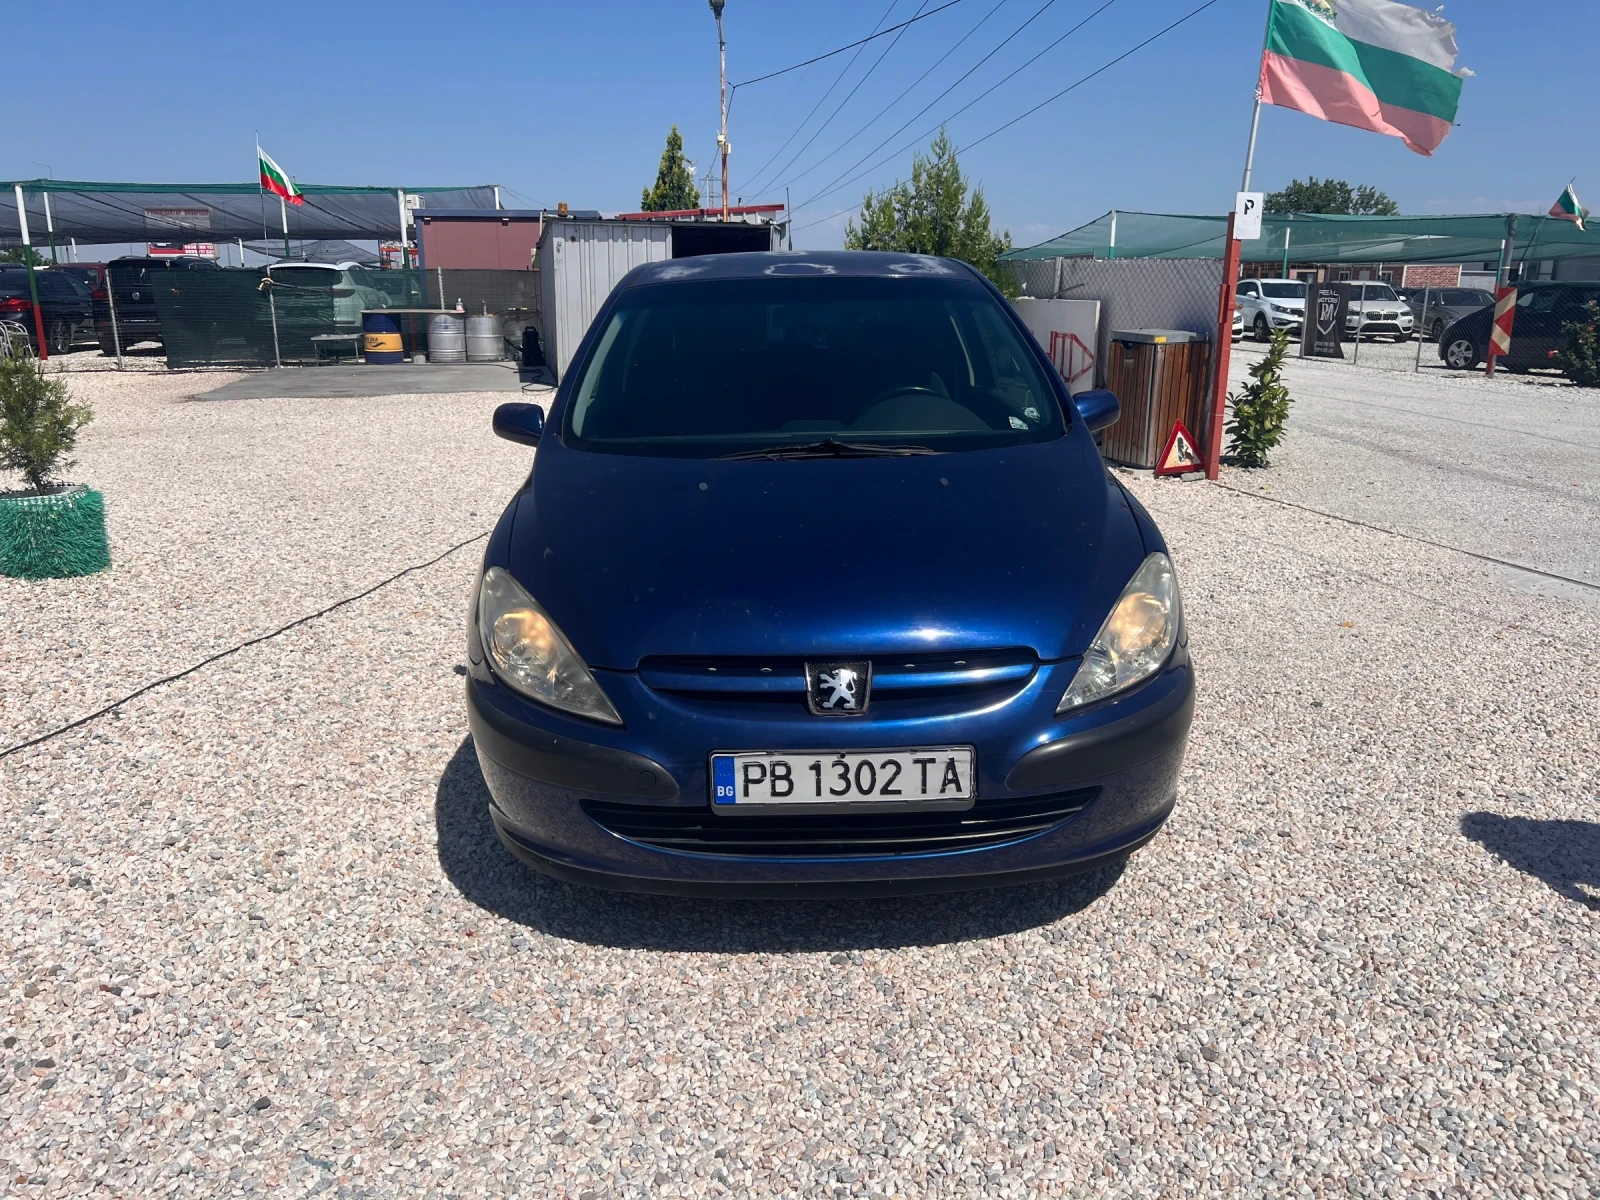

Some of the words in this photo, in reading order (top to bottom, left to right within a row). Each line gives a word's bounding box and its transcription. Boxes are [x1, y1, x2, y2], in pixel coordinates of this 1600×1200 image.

[1244, 199, 1255, 215] P
[742, 760, 794, 797] PB
[808, 759, 902, 796] 1302
[912, 757, 963, 794] TA
[717, 786, 734, 797] BG
